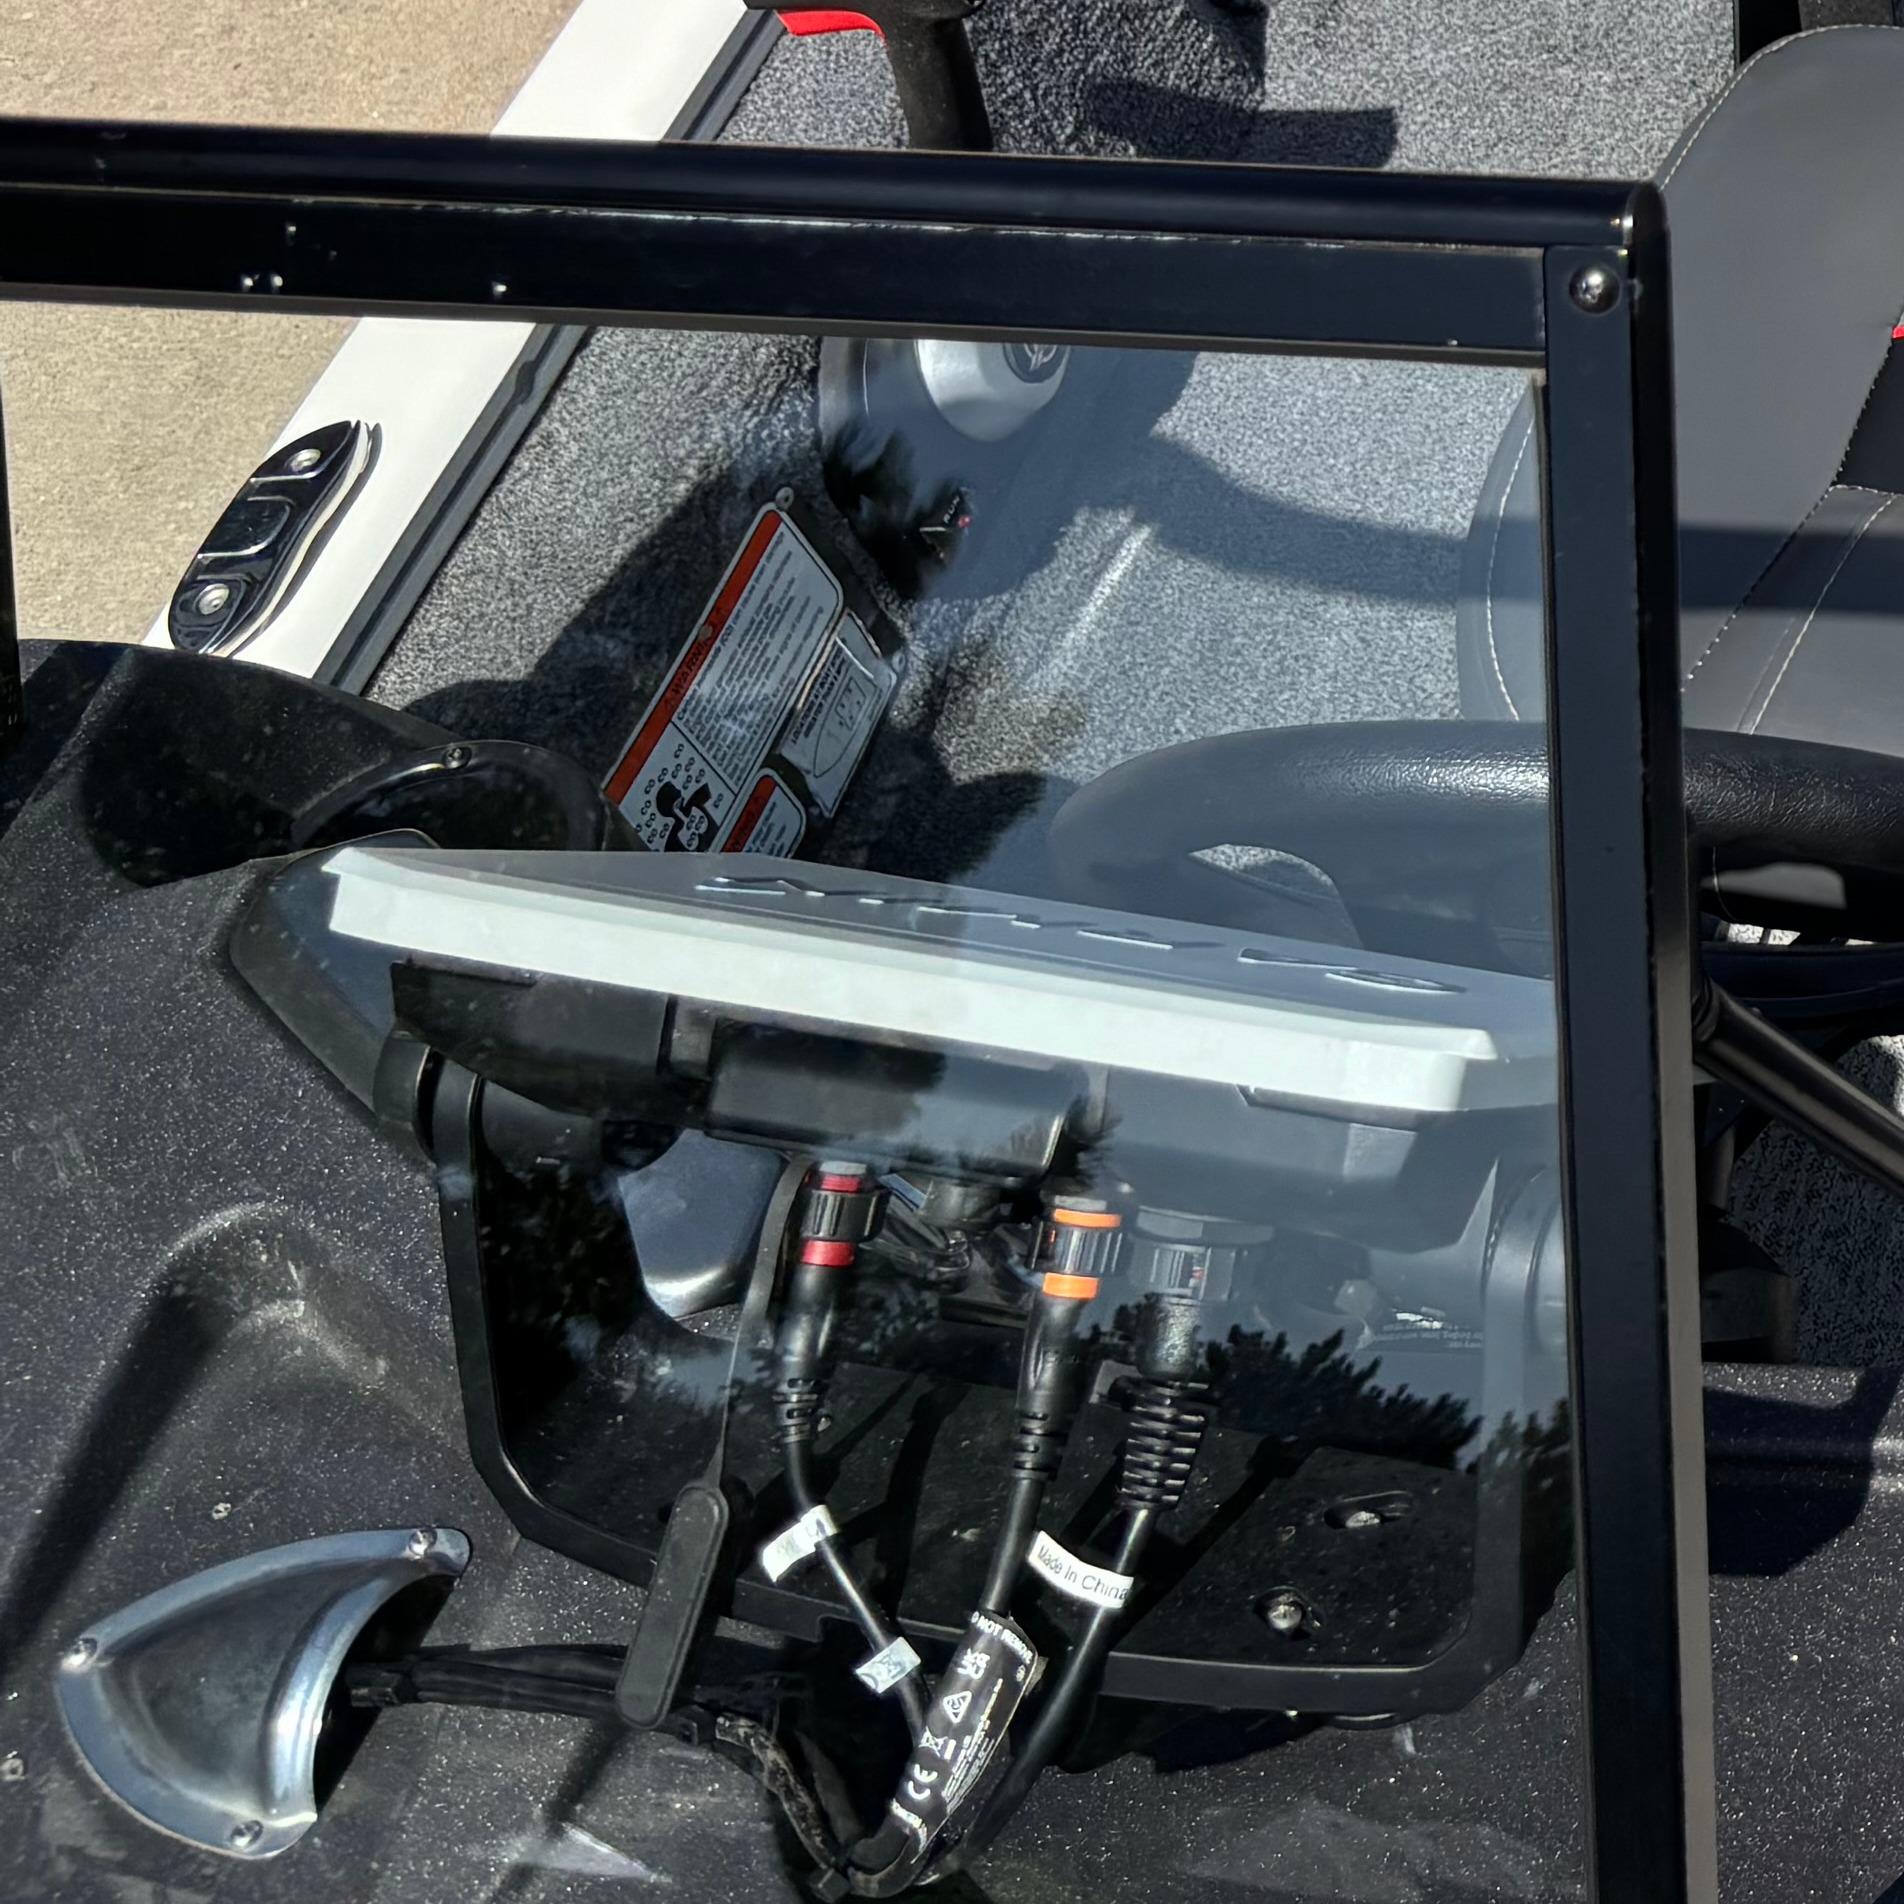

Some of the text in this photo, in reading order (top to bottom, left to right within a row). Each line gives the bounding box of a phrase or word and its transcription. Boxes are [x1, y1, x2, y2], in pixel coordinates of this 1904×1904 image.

[674, 744, 685, 758] CO
[671, 763, 682, 779] CO
[684, 757, 695, 772] CO
[657, 768, 669, 783] CO
[682, 775, 693, 790] CO
[695, 769, 706, 783] CO
[644, 779, 656, 794] CO
[640, 800, 652, 815] CO
[712, 793, 724, 808] CO
[645, 813, 656, 828] CO
[647, 828, 658, 844] CO
[659, 823, 671, 839] CO
[1038, 1545, 1062, 1574] Made
[1082, 1575, 1129, 1600] China
[977, 1616, 1003, 1635] NOT
[908, 1763, 938, 1800] CE
